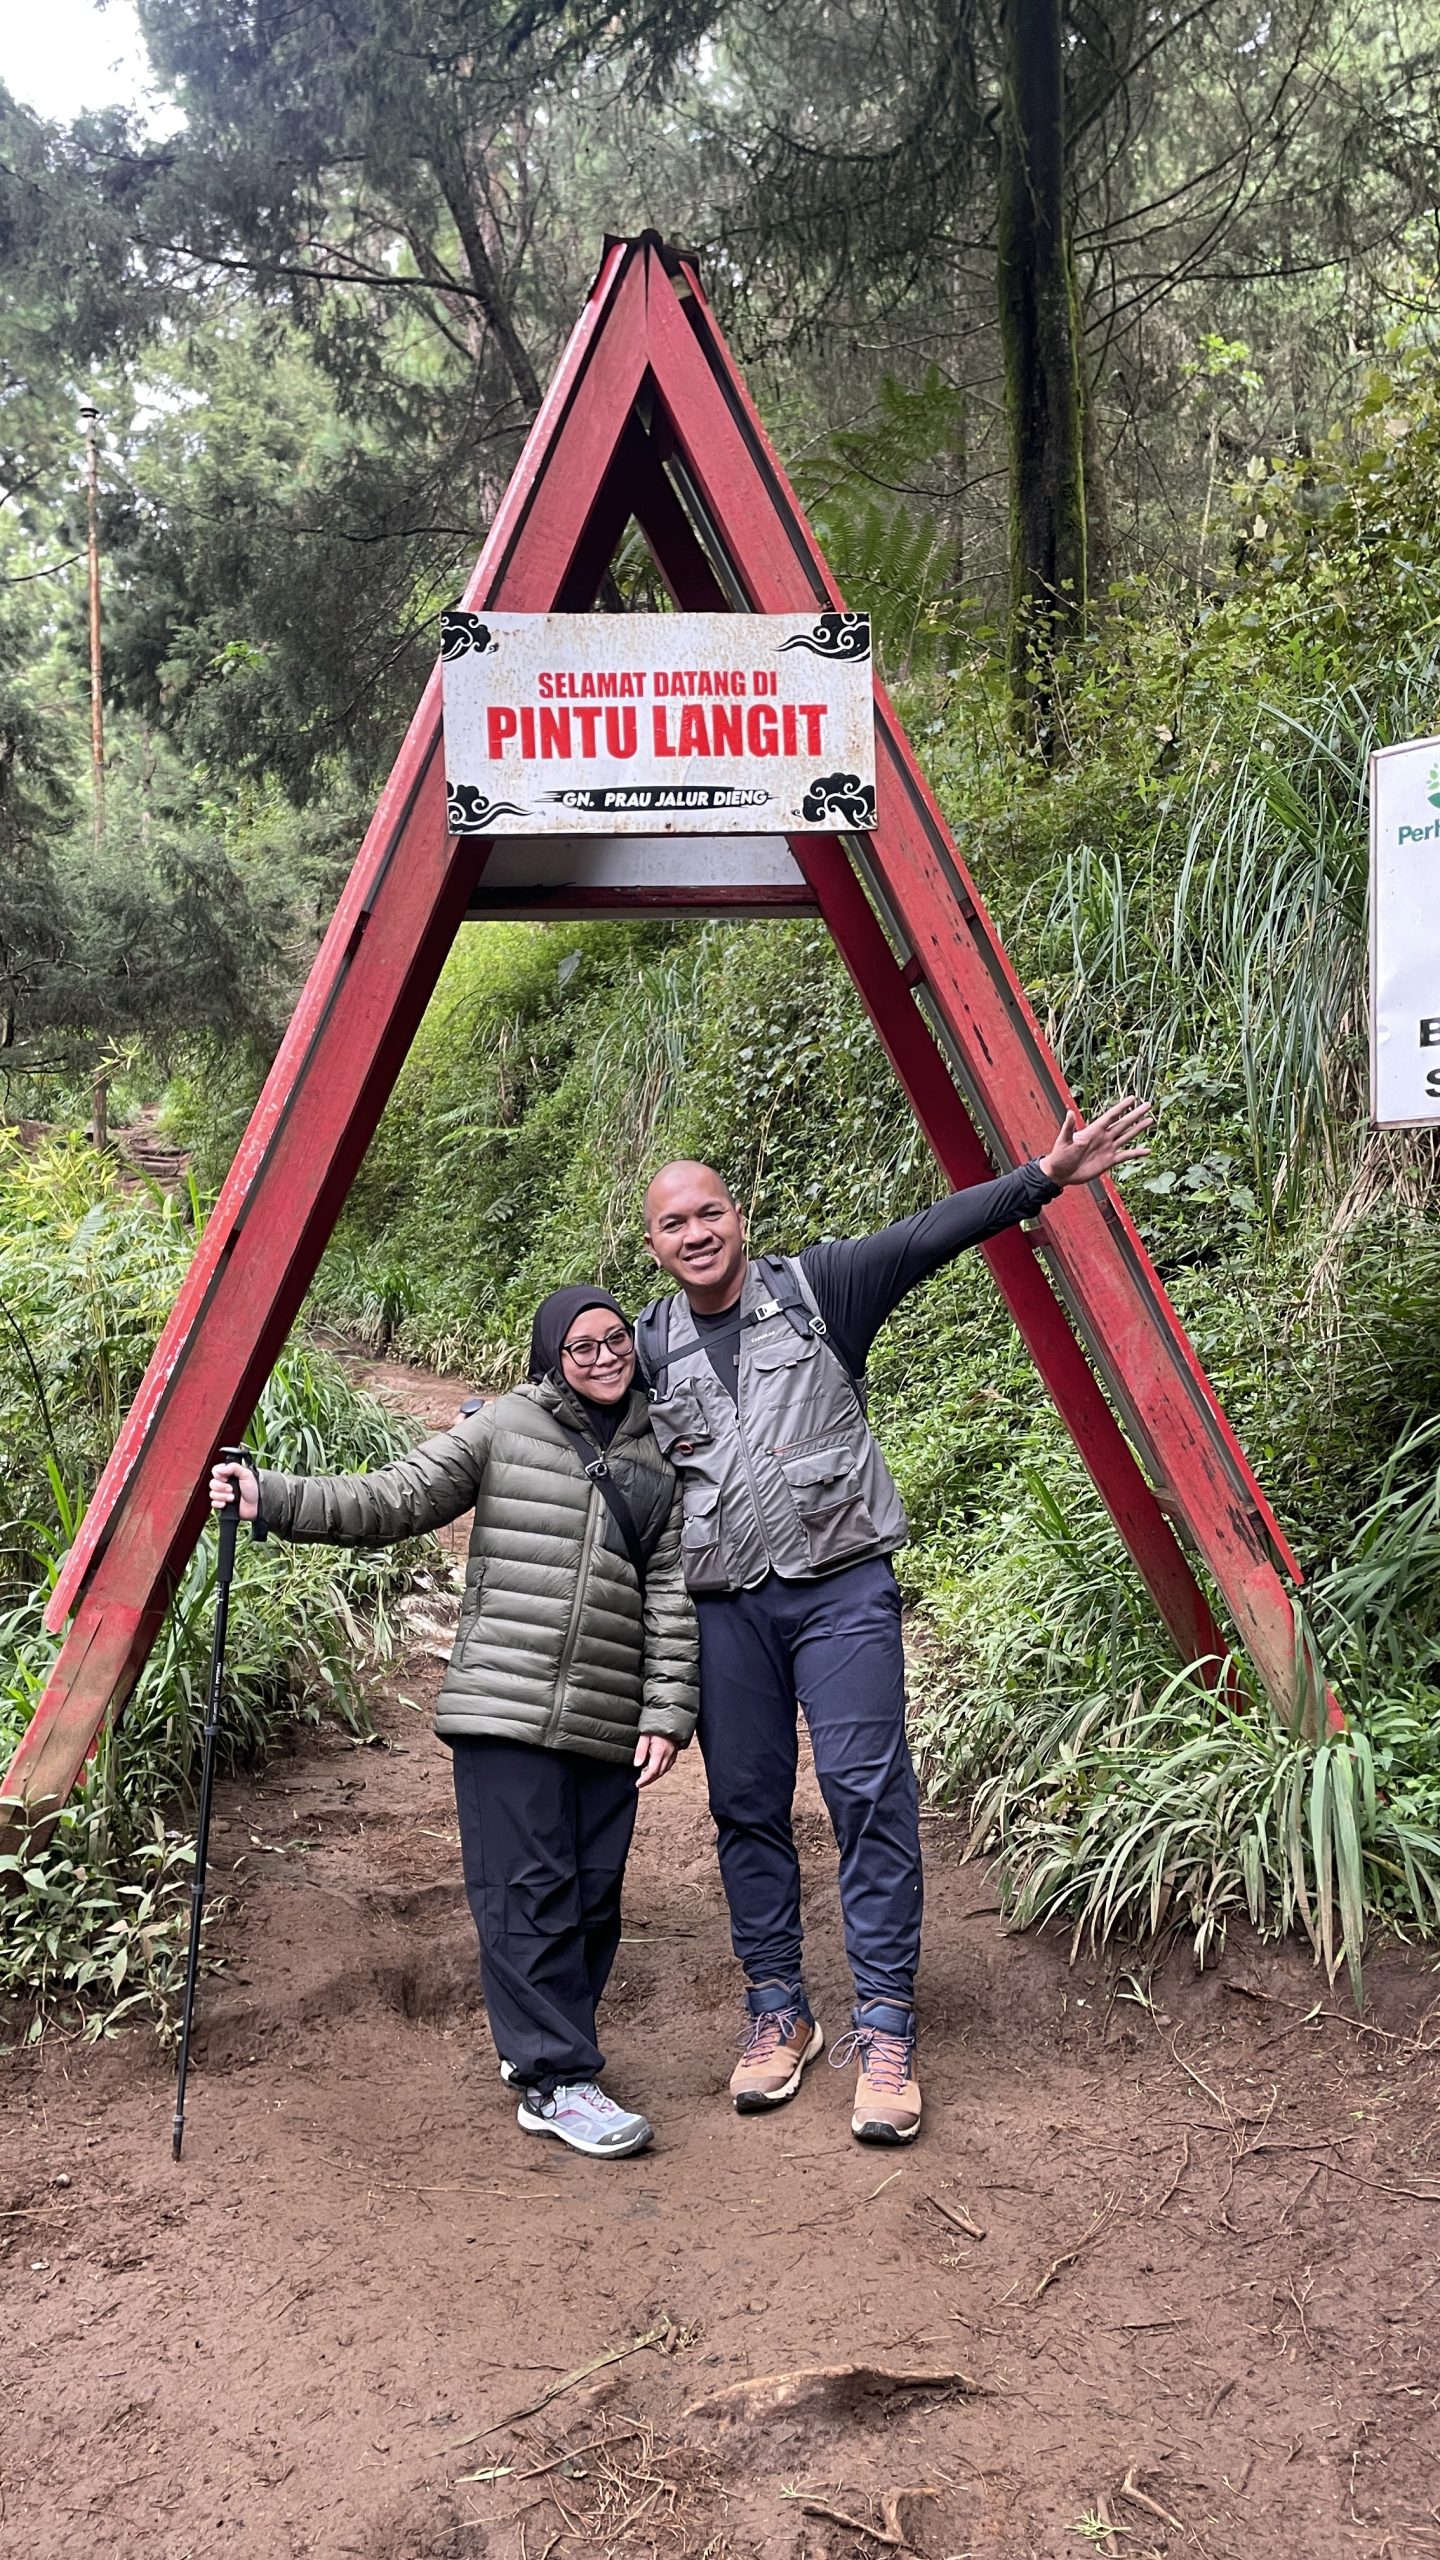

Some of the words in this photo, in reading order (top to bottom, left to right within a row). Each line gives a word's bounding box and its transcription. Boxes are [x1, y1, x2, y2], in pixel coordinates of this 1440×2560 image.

[538, 672, 646, 699] SELAMAT
[653, 671, 746, 697] DATANG
[753, 671, 777, 696] DI
[486, 705, 638, 760] PINTU
[652, 704, 828, 758] LANGIT
[562, 791, 595, 807] GN.
[604, 791, 652, 807] PRAU
[654, 789, 710, 807] JALUR
[712, 789, 769, 806] DIENG
